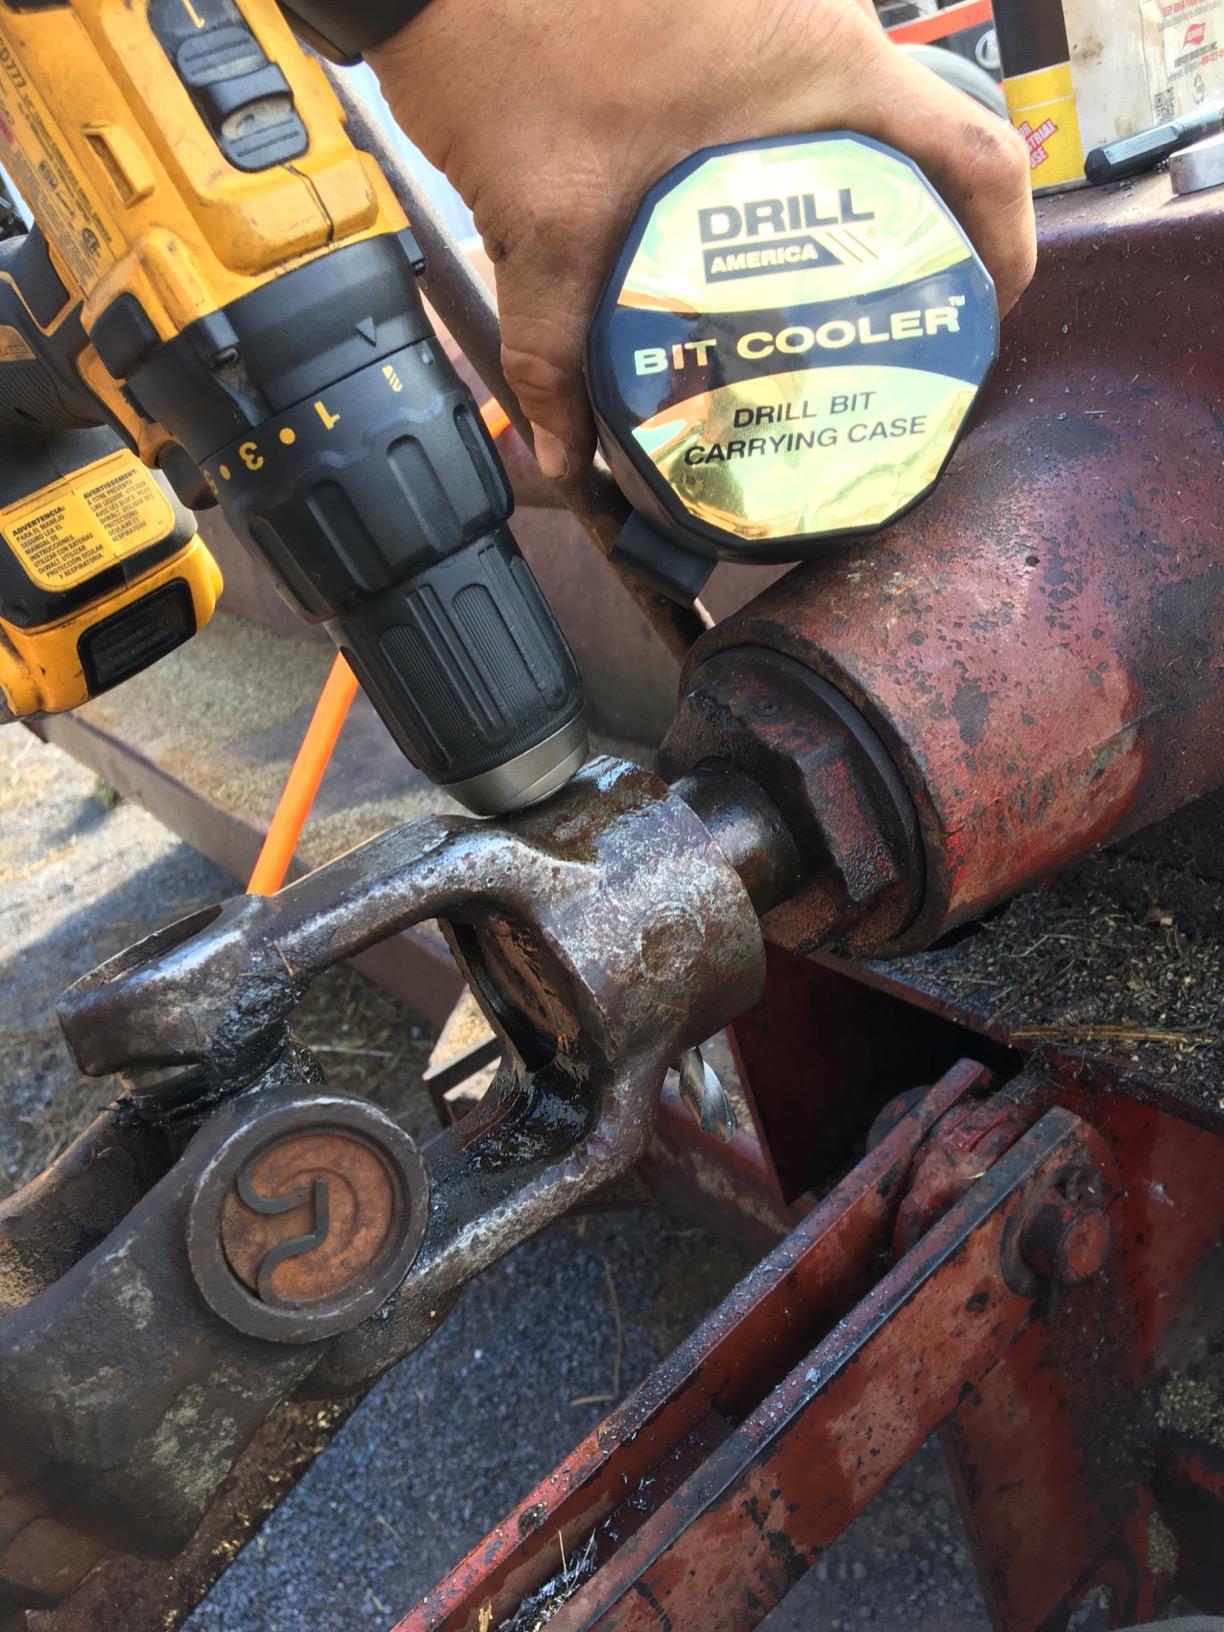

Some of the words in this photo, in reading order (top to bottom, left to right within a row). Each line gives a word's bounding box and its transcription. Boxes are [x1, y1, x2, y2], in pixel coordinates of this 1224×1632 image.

[698, 188, 875, 243] DRILL
[710, 243, 819, 274] AMERICA
[634, 339, 717, 376] BIT
[733, 402, 818, 429] DRILL
[830, 391, 877, 415] BIT
[684, 428, 838, 466] CARRYING
[847, 415, 928, 443] CASE
